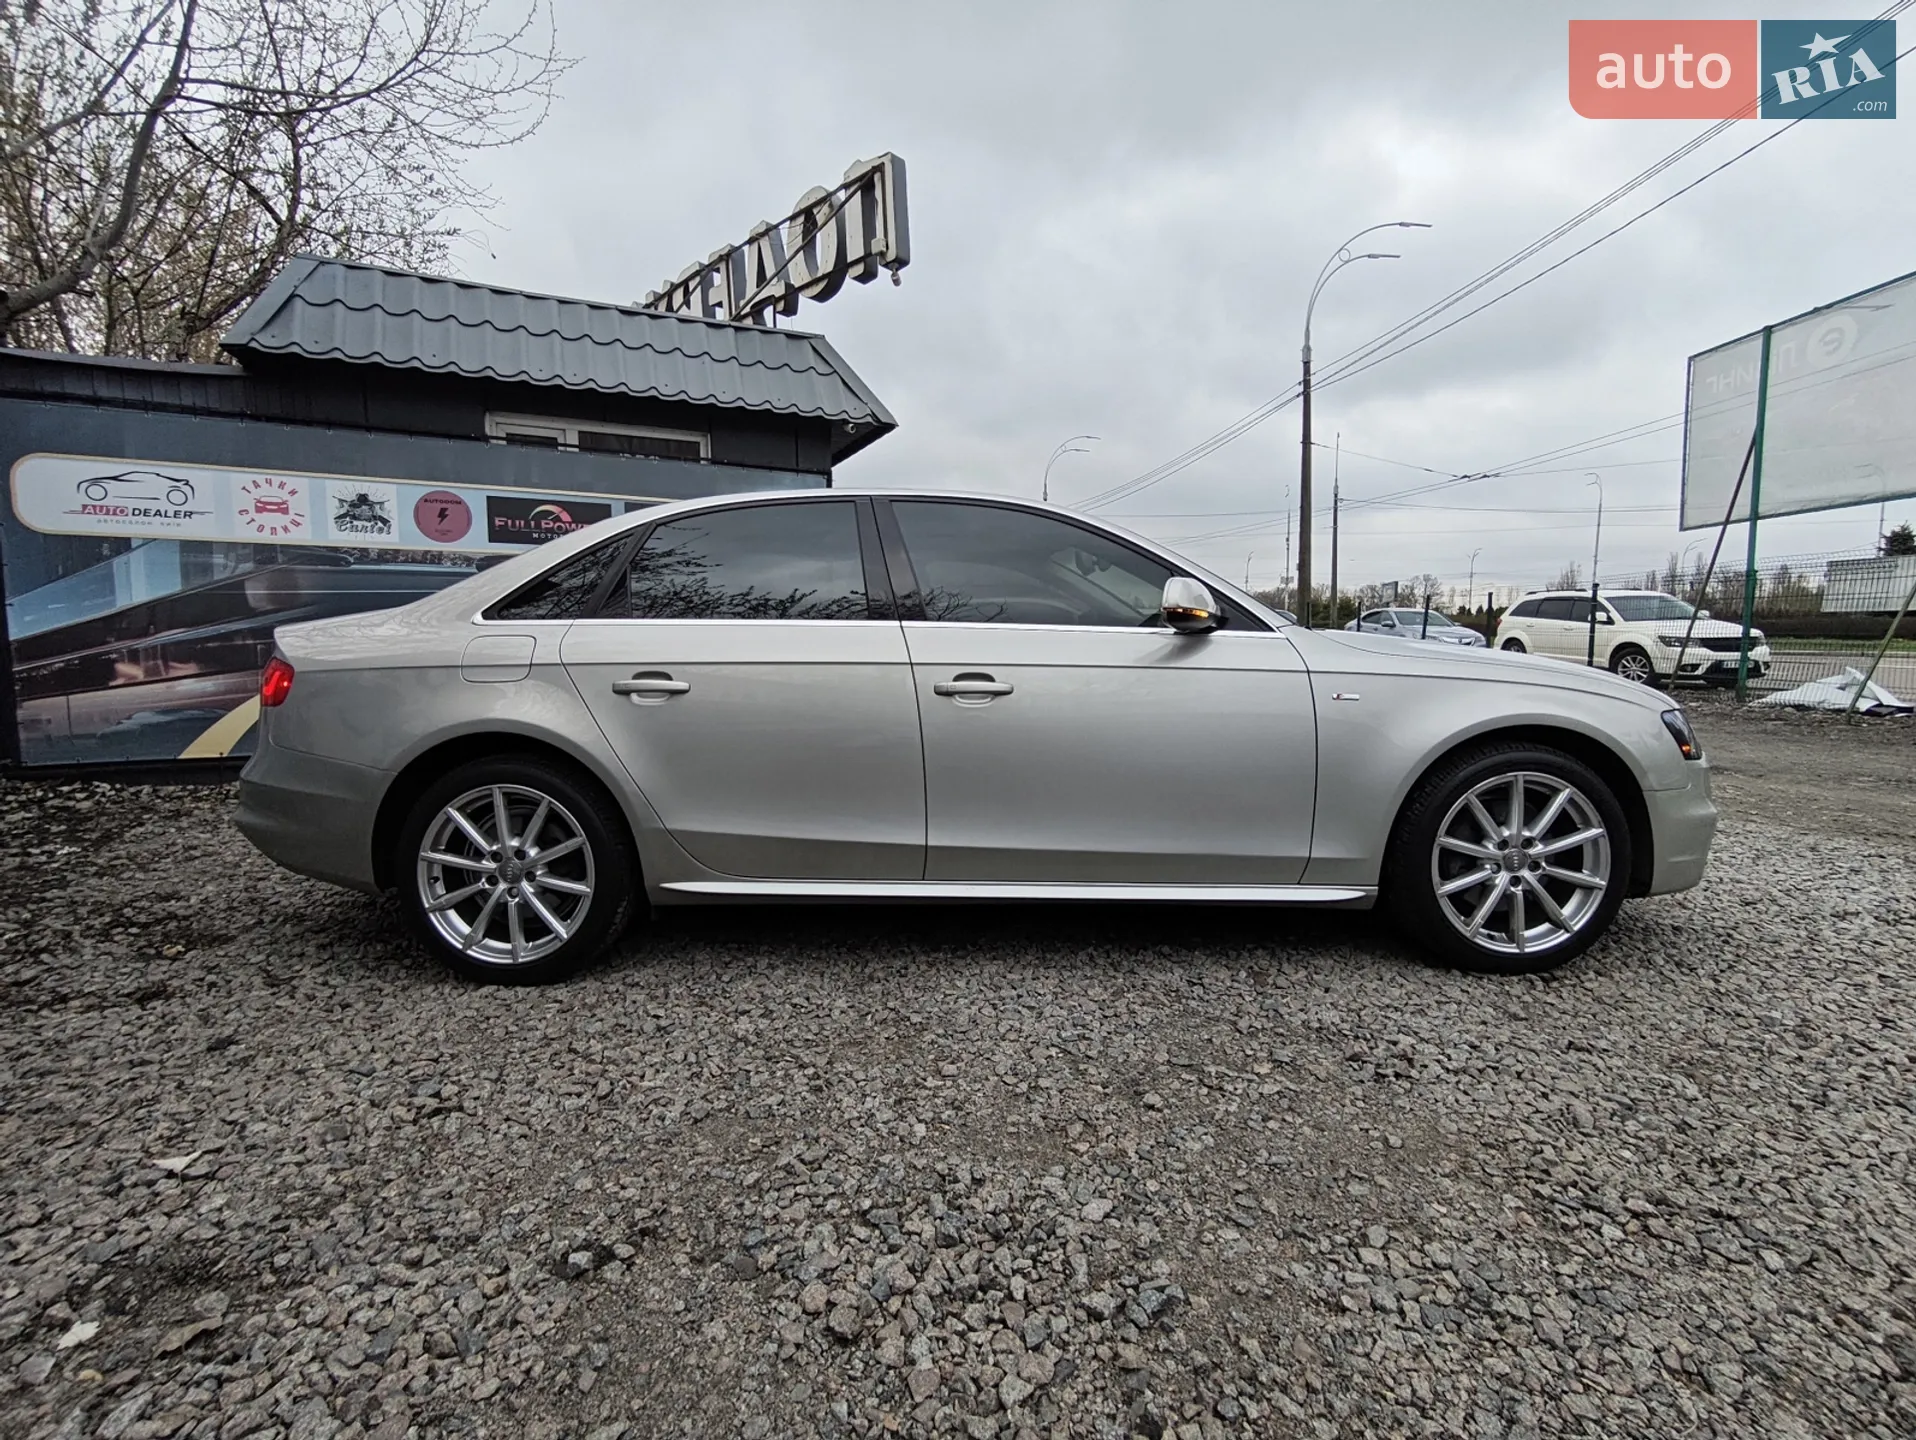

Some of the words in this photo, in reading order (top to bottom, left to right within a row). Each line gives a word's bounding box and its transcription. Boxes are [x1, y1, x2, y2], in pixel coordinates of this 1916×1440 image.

[241, 477, 299, 497] ТАЧКИ
[84, 505, 128, 517] AUTO
[131, 507, 194, 519] DEALER
[238, 508, 305, 536] СТОЛИЦІ
[494, 516, 592, 533] FULLPOW
